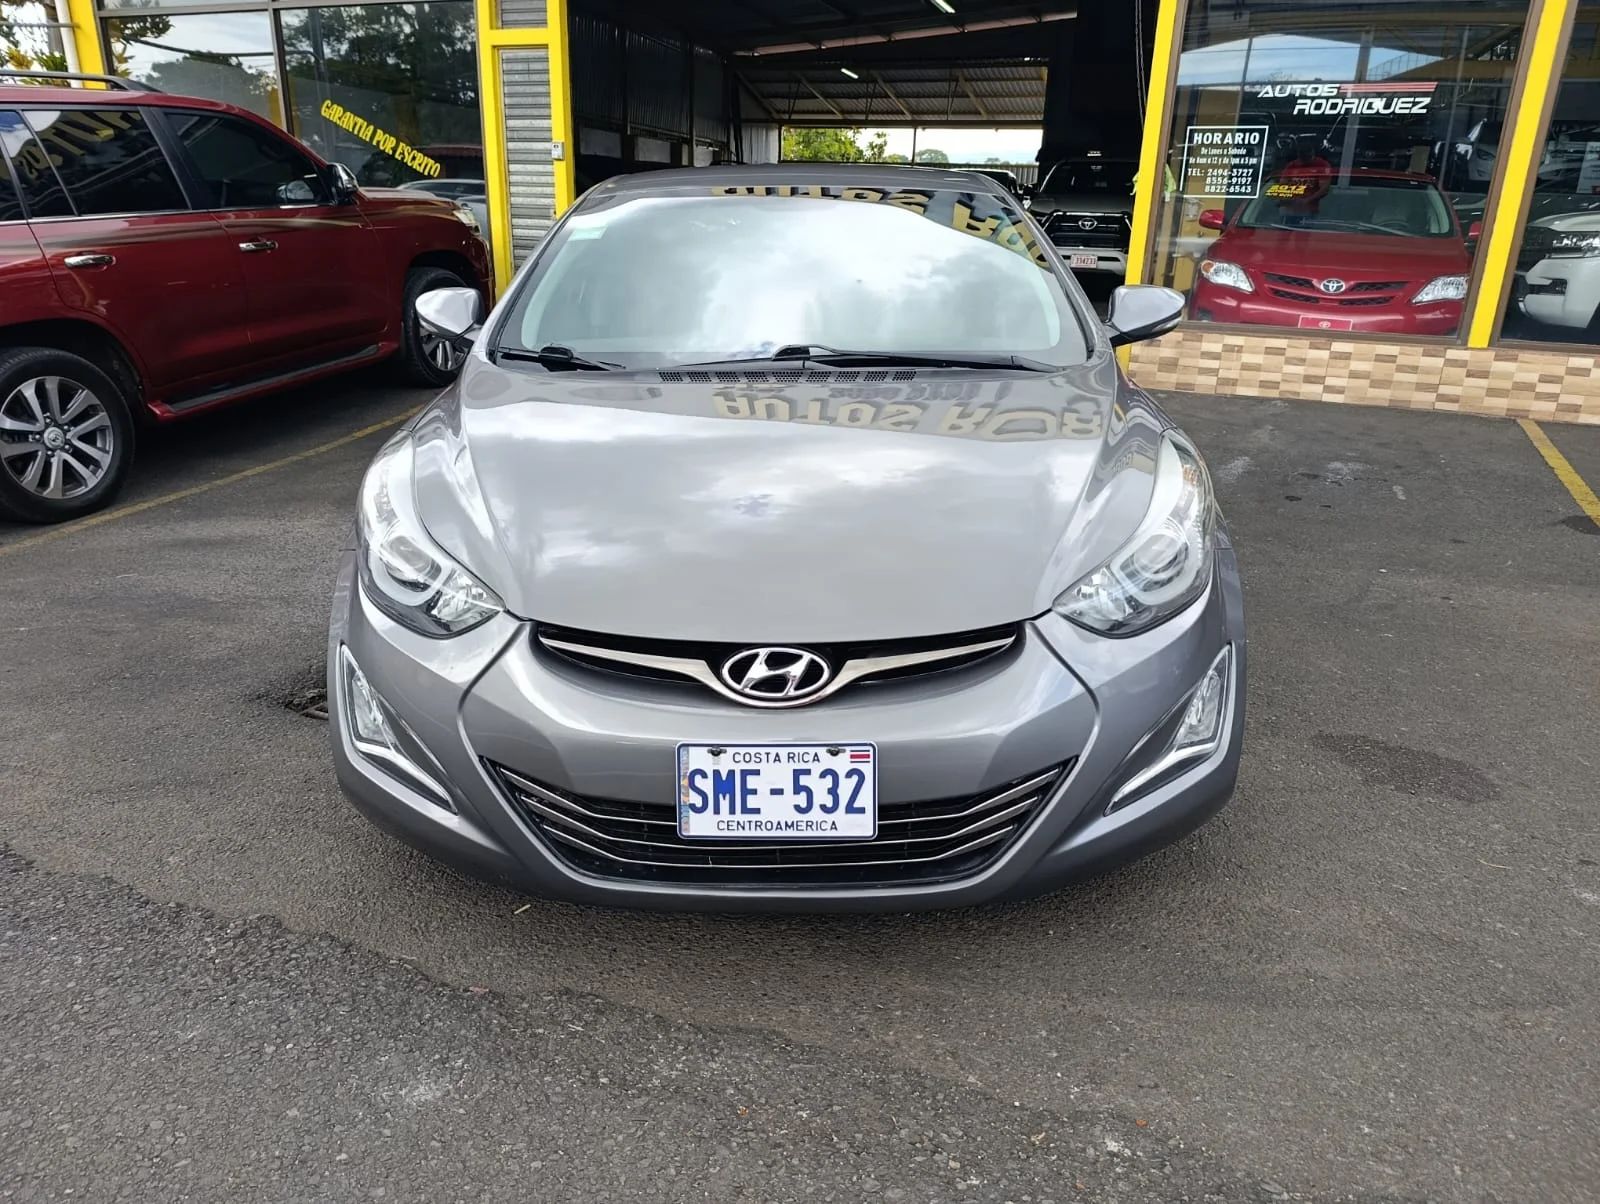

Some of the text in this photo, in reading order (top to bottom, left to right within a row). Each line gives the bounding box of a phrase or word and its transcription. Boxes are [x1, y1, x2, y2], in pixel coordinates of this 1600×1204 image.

[1257, 84, 1340, 97] AUTOS
[1293, 97, 1431, 115] RODRIGUEZ
[320, 100, 441, 178] GARANTIA POR ESCRITO
[1193, 132, 1260, 145] HORARIO
[1188, 168, 1205, 176] TEL:
[732, 751, 821, 764] COSTA RICA
[688, 768, 866, 815] SME-532
[716, 819, 839, 832] CENTROAMERICA
